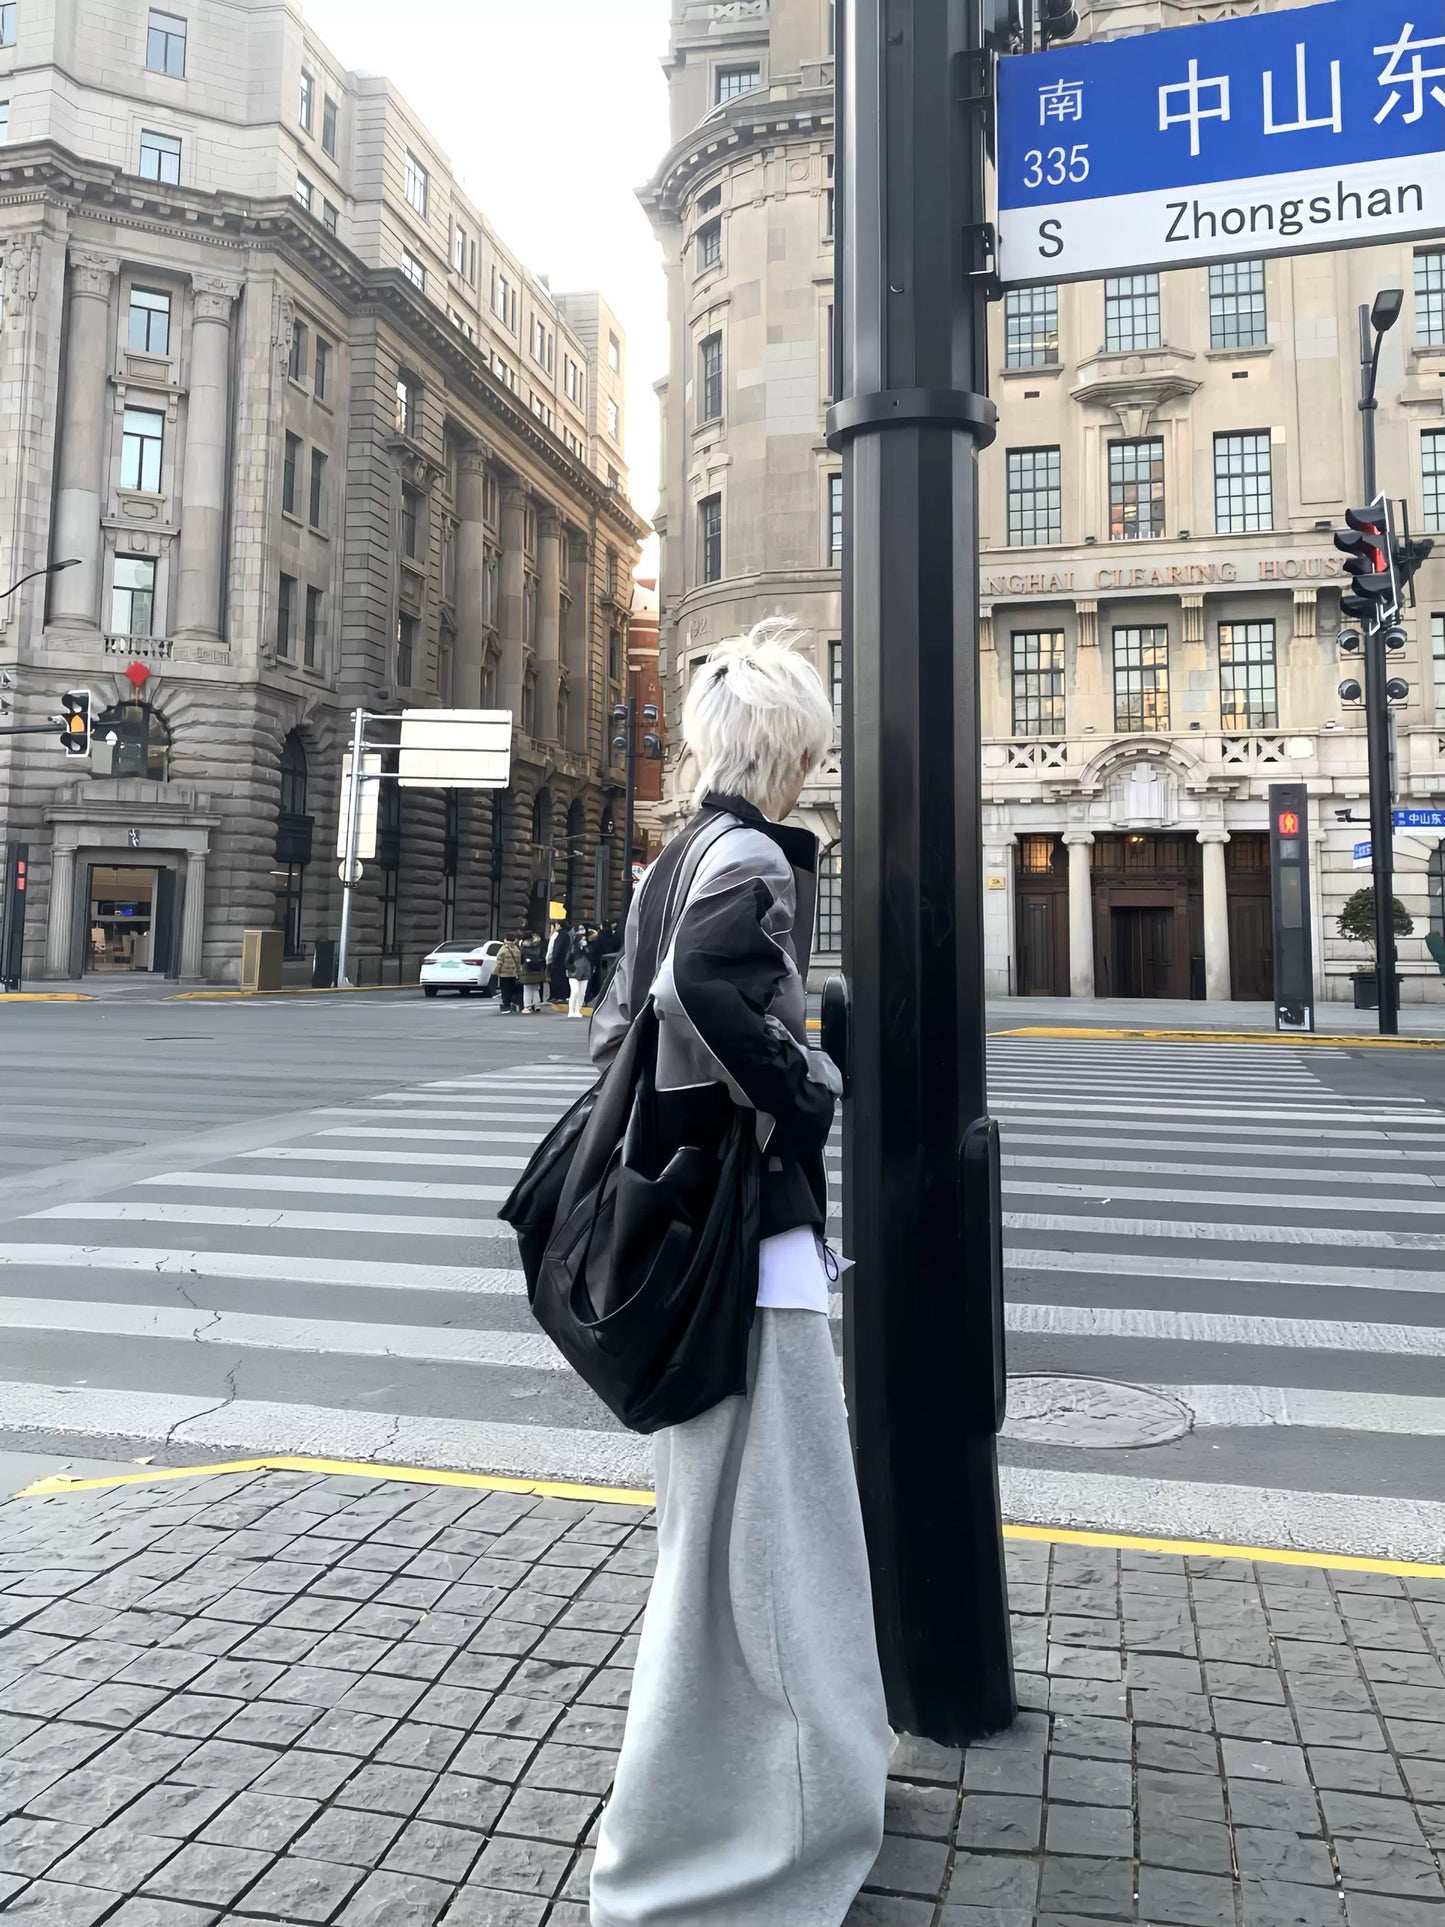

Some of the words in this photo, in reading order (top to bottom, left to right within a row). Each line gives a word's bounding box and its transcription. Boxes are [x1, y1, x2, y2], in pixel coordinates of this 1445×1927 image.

[1038, 78, 1085, 126] 南
[1158, 23, 1445, 157] 中山东
[1023, 143, 1090, 188] 335
[1038, 219, 1064, 258] S
[1165, 181, 1424, 243] Zhongshan
[1094, 562, 1237, 588] CLEARING
[1258, 557, 1346, 581] HOUS
